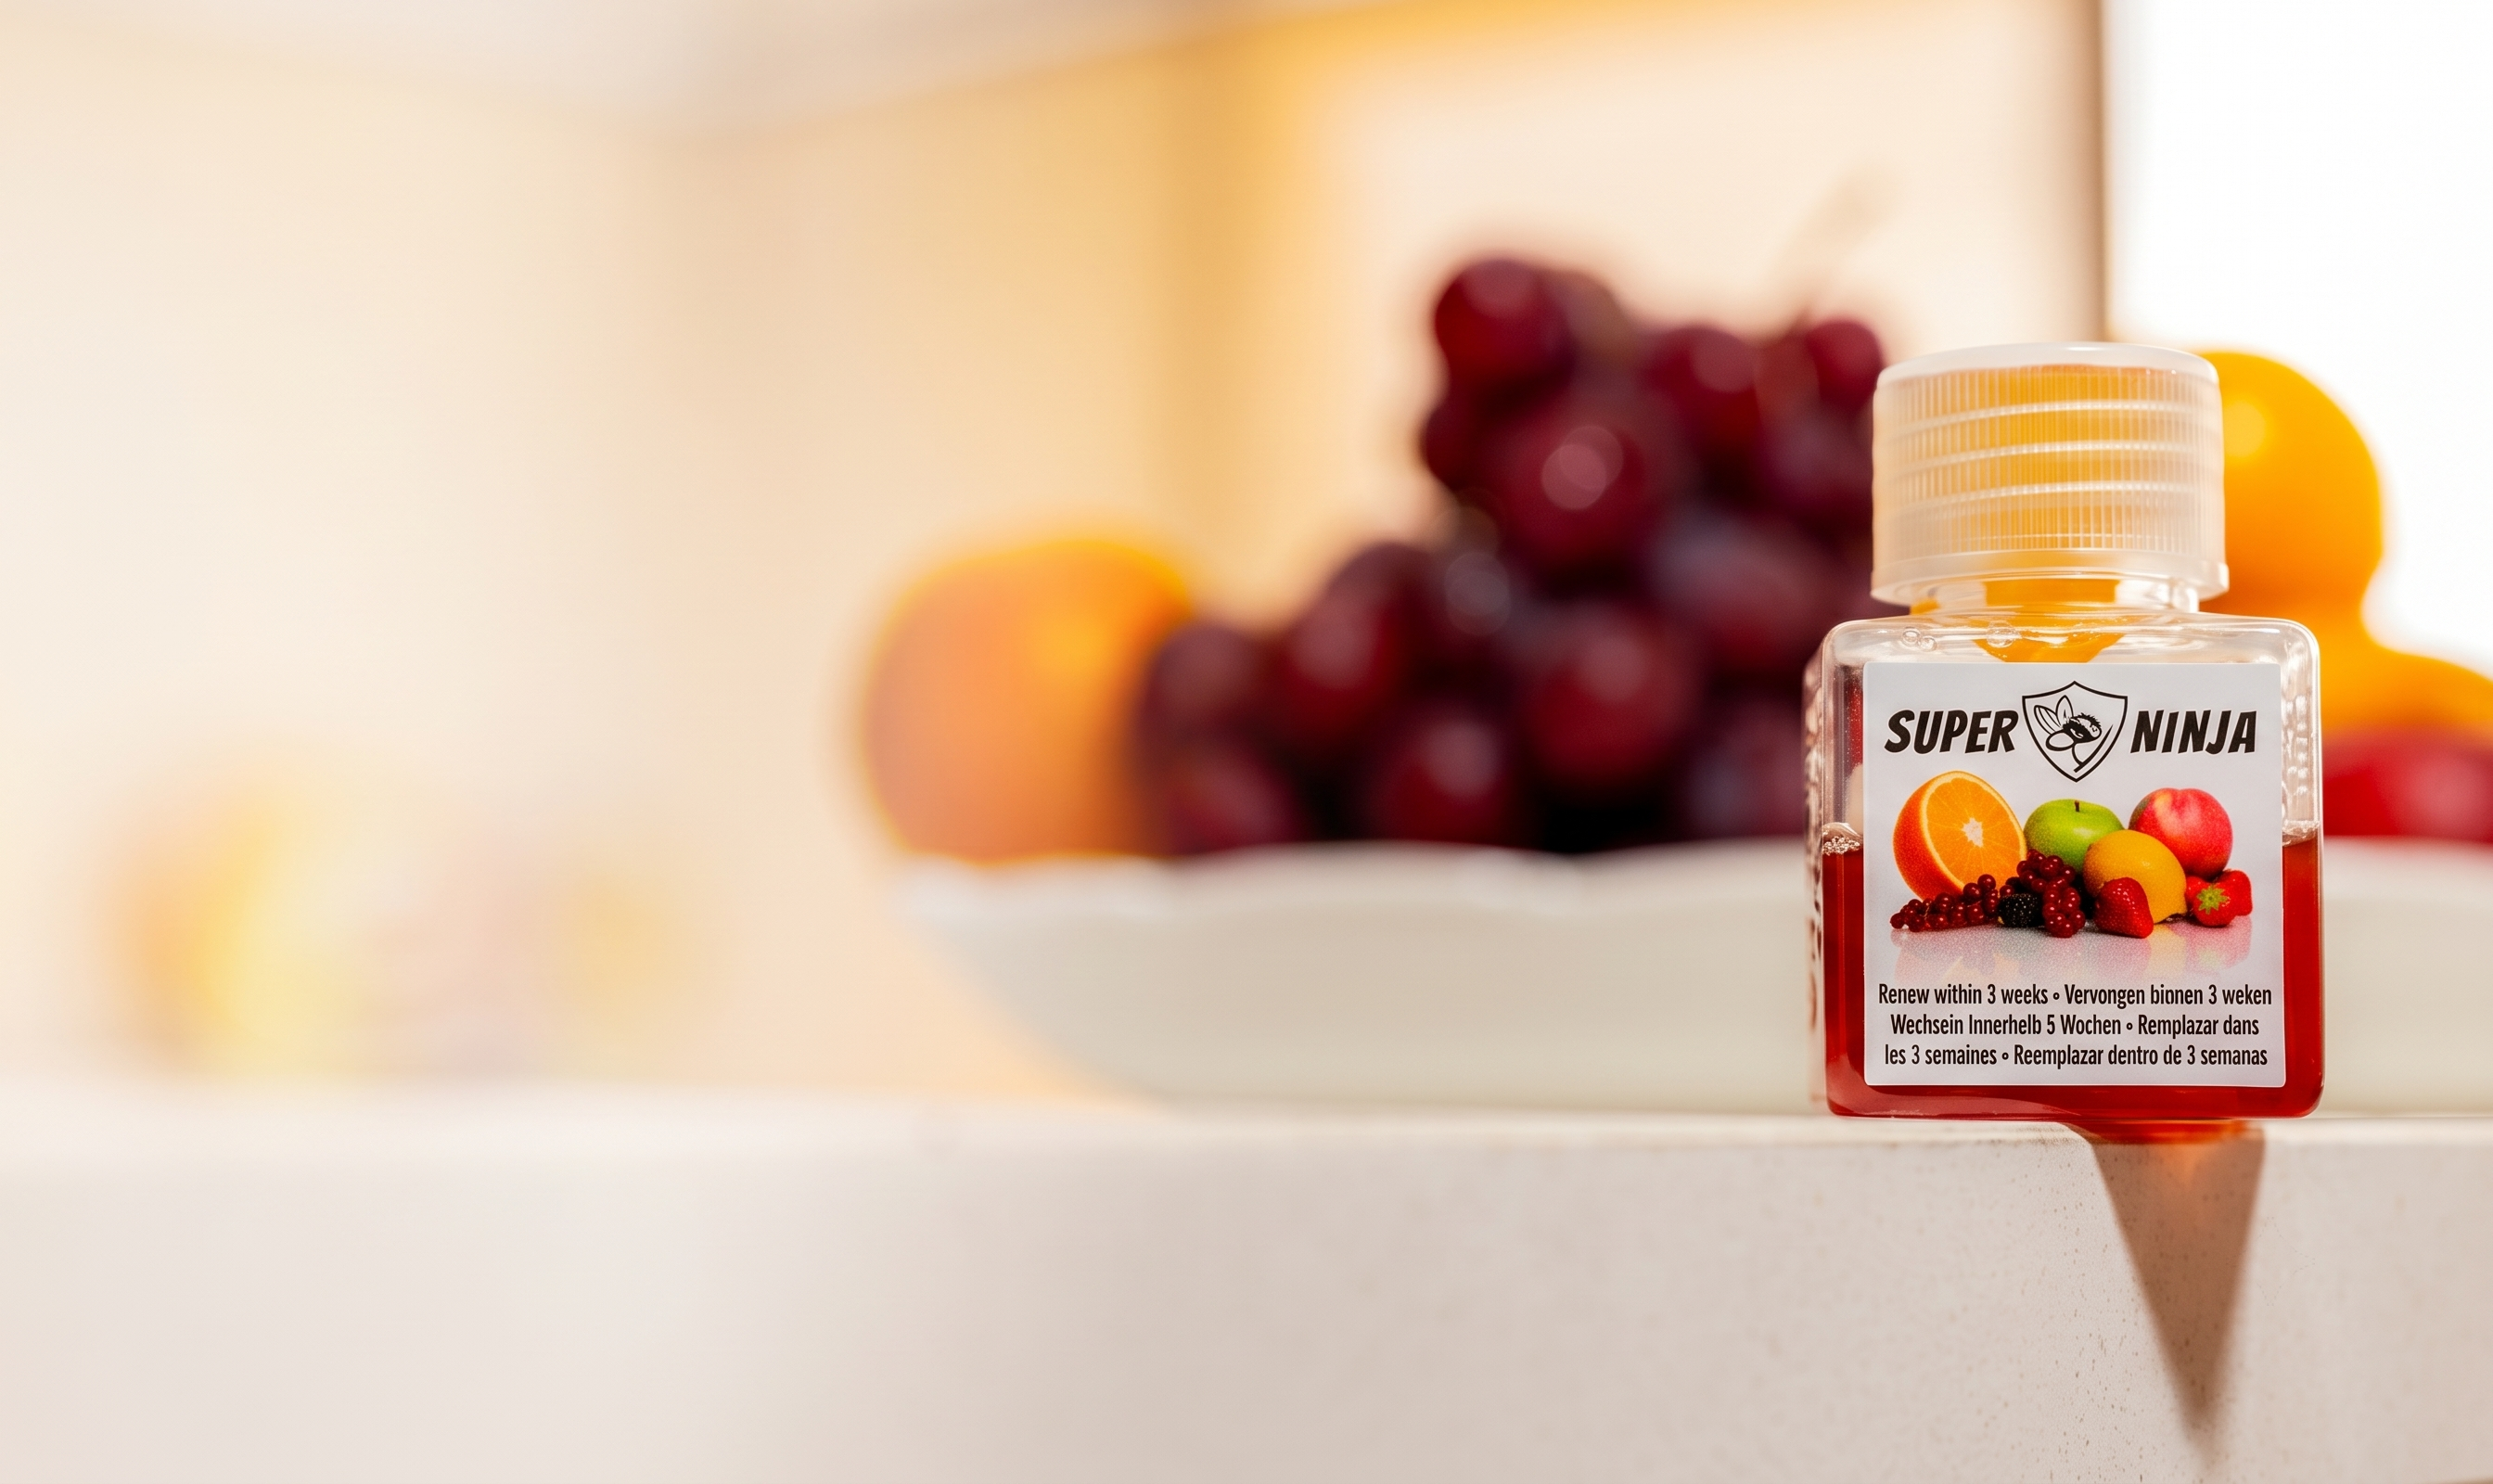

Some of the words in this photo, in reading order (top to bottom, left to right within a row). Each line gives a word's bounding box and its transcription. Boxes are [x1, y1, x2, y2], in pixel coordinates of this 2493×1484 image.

[1884, 710, 2019, 755] SUPER
[2129, 710, 2257, 755] NINJA
[1878, 983, 1930, 1004] Renew
[1934, 983, 1982, 1004] within
[1987, 983, 1996, 1004] 3
[2001, 983, 2049, 1004] weeks
[2064, 983, 2145, 1010] Vervongen
[2208, 984, 2218, 1005] 3
[2221, 983, 2272, 1005] weken
[1890, 1013, 1963, 1035] Wechsein
[1969, 1014, 2042, 1035] Innerhelb
[2046, 1014, 2056, 1035] 5
[2060, 1014, 2121, 1035] Wochen
[2138, 1014, 2219, 1040] Remplazar
[2222, 1014, 2259, 1035] dans
[1885, 1043, 1907, 1065] les
[1911, 1044, 1920, 1065] 3
[1924, 1043, 1998, 1066] semaines
[2014, 1043, 2104, 1070] Reemplazar
[2107, 1043, 2158, 1066] dentro
[2163, 1043, 2182, 1066] de
[2187, 1044, 2196, 1066] 3
[2200, 1049, 2268, 1066] semanas
